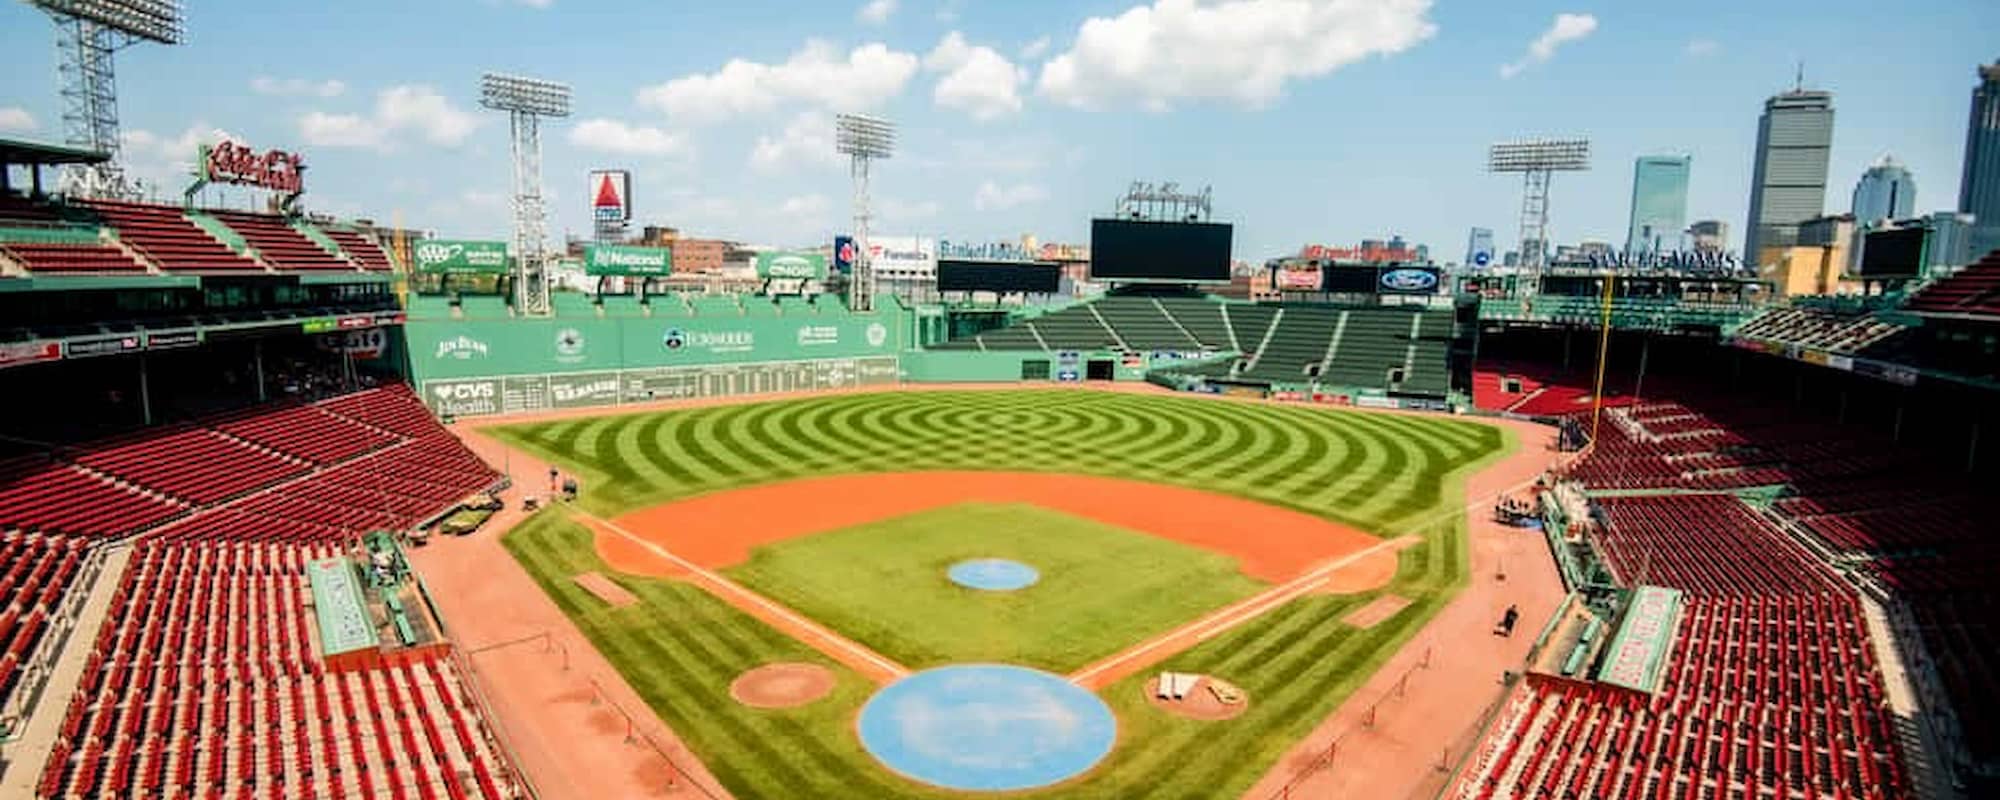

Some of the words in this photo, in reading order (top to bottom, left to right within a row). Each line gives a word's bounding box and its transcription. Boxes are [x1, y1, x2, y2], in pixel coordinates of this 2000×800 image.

[611, 251, 665, 266] National
[455, 383, 494, 399] CVS
[438, 401, 495, 416] Health
